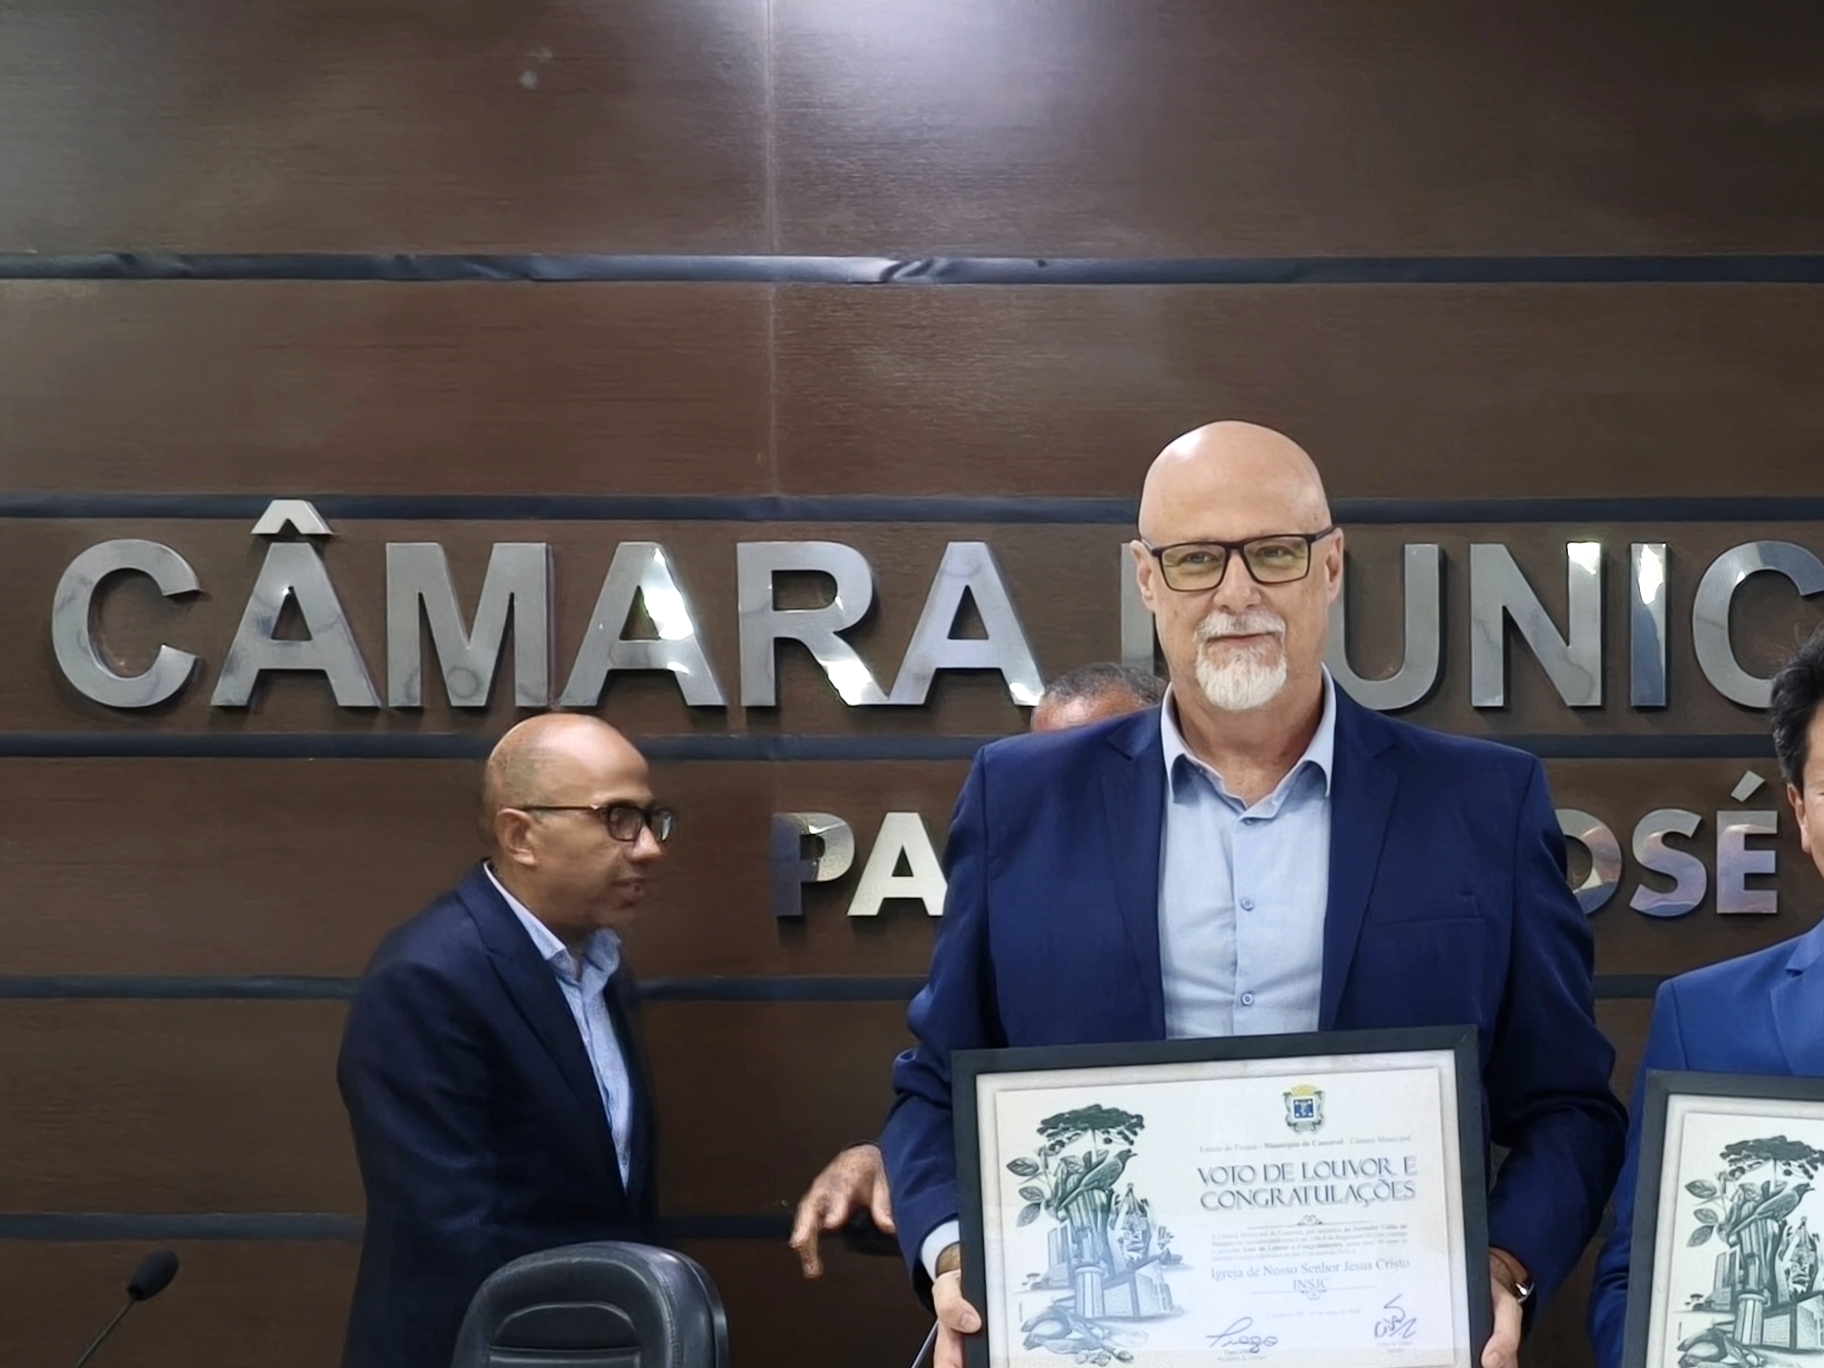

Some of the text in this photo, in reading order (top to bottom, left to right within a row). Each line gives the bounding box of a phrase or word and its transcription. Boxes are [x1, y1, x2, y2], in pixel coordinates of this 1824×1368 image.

[52, 498, 1046, 709] CÂMARA
[1560, 770, 1780, 919] OSÉ
[1197, 1156, 1418, 1187] VOTO DE LOUVOR E
[1199, 1179, 1417, 1212] CONGRATULAÇÕES
[1210, 1257, 1410, 1282] Igreja de Nosso Senhor Jesus Cristo
